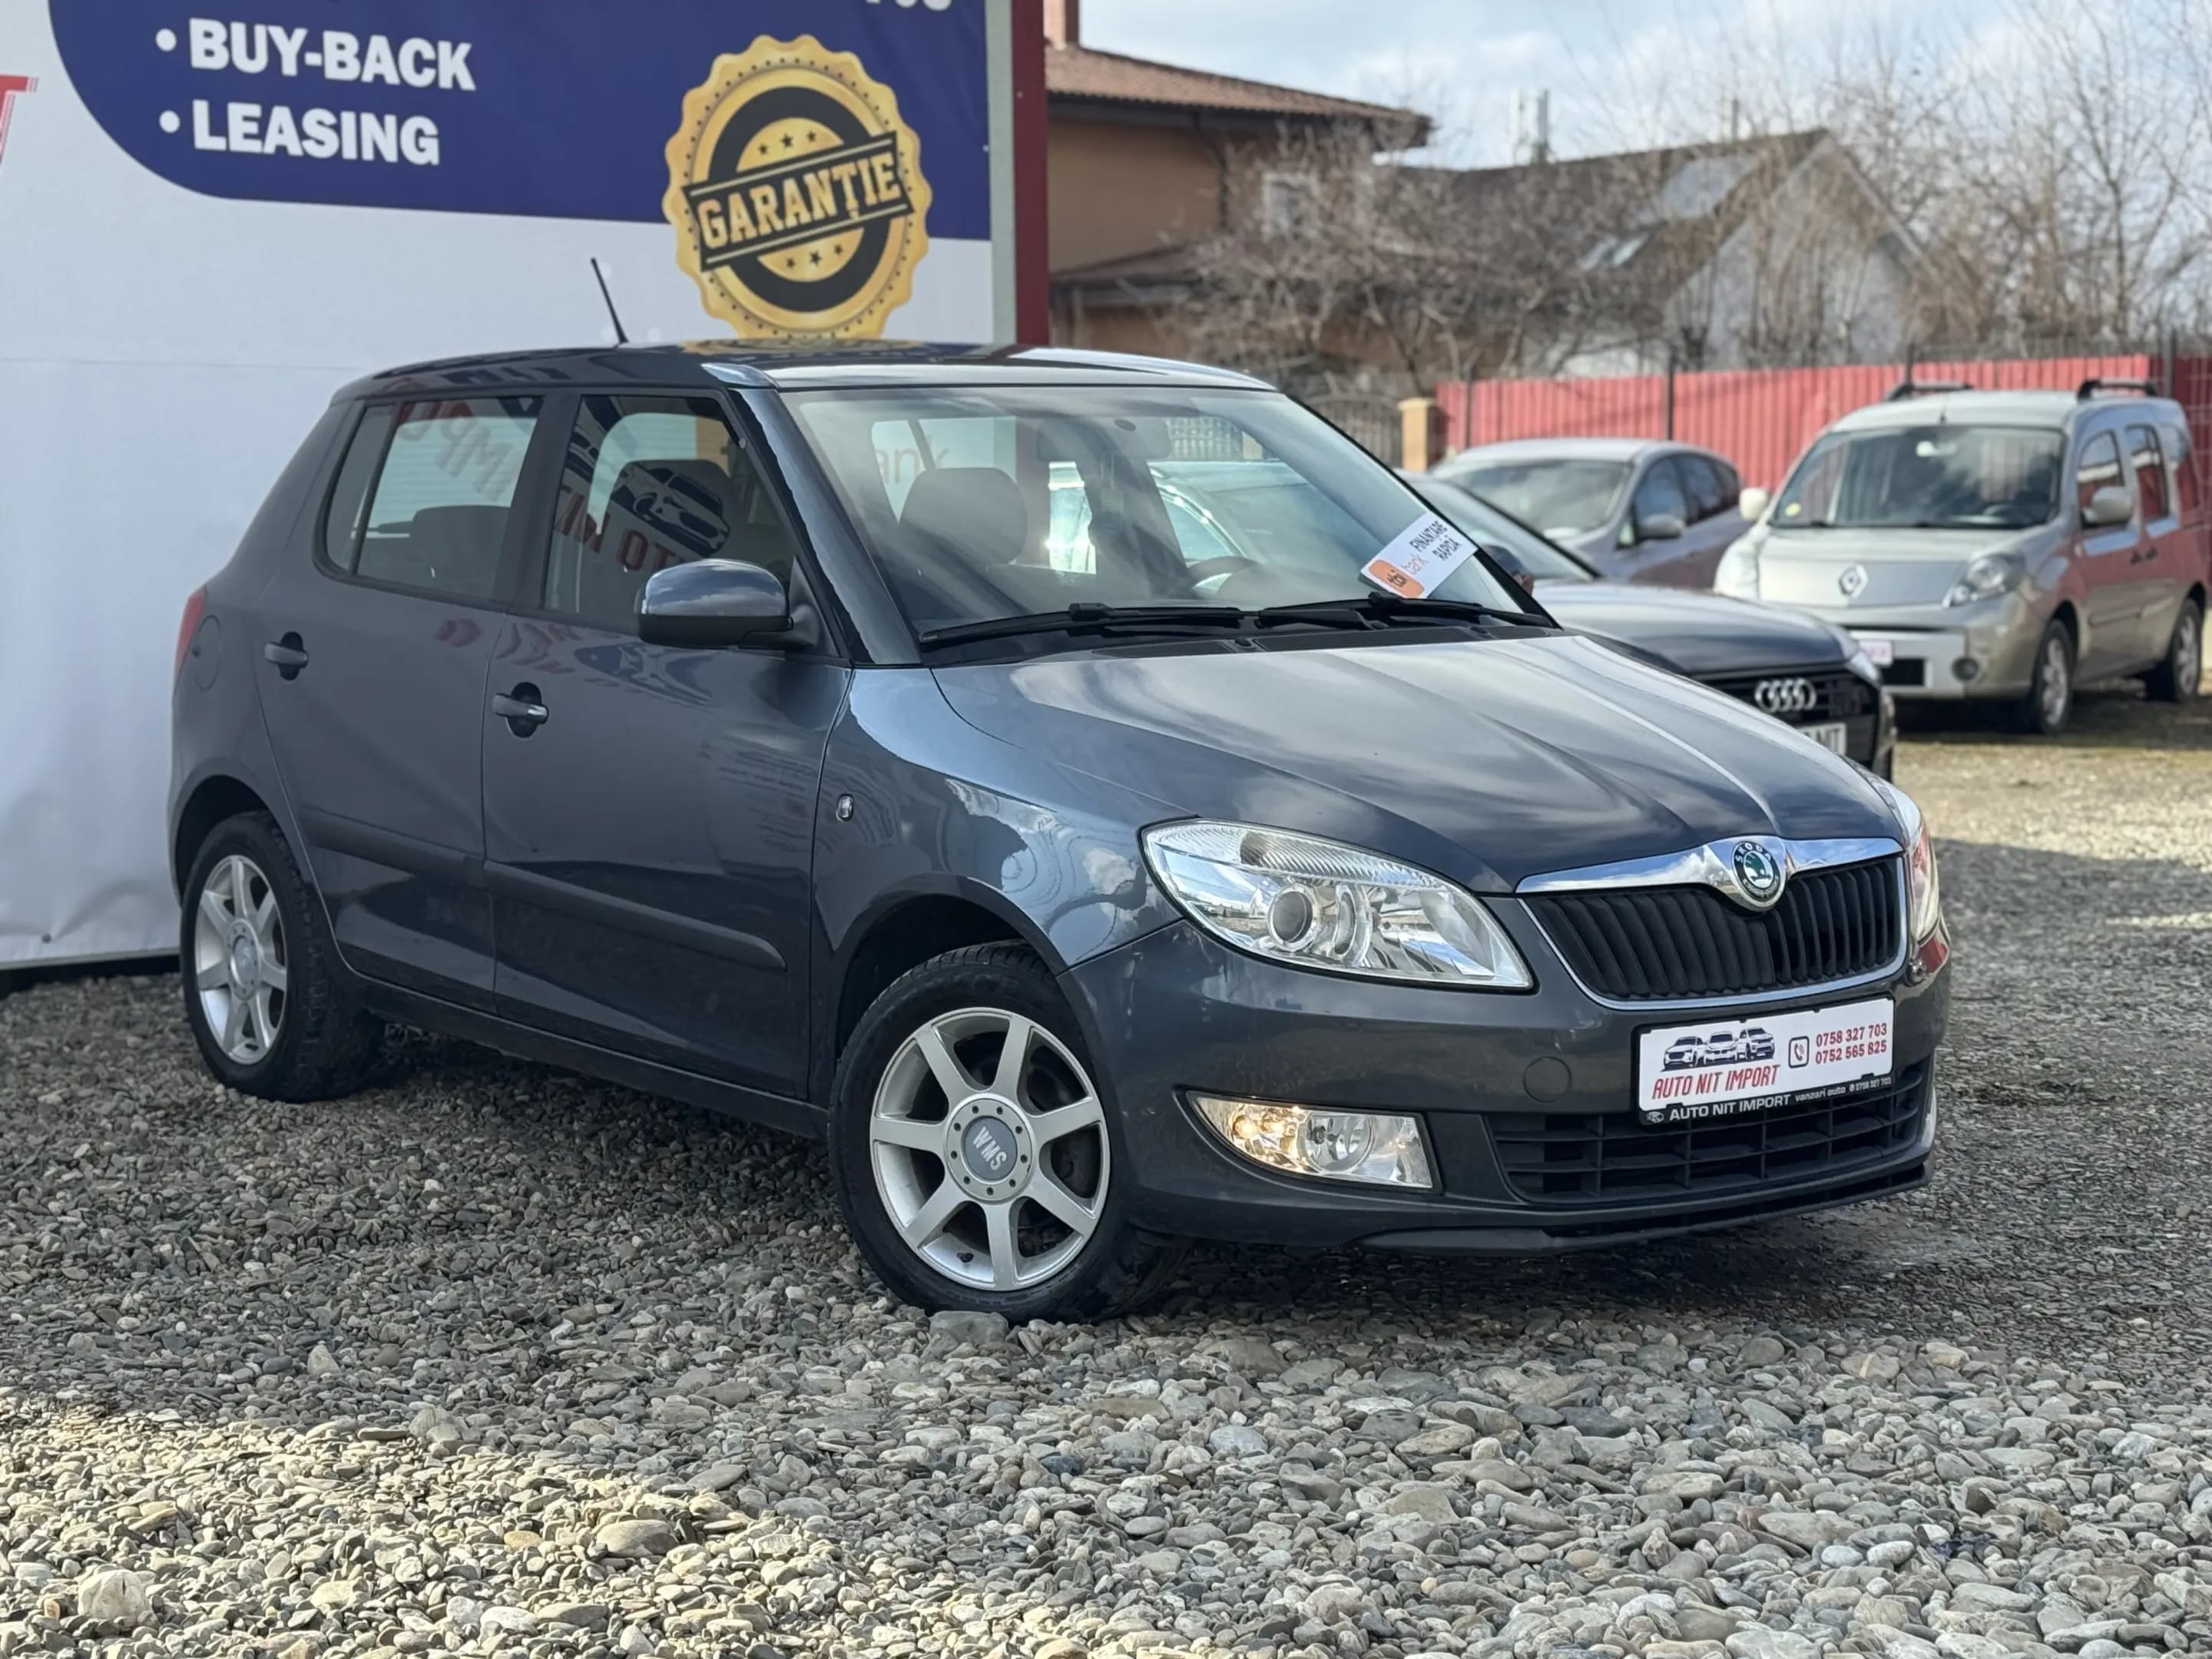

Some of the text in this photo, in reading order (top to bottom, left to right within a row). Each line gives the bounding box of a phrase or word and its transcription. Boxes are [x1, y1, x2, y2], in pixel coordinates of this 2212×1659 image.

[189, 18, 476, 91] BUY-BACK
[193, 99, 440, 166] LEASING
[1400, 553, 1429, 575] bank
[1816, 1022, 1887, 1047] 0758 327 703
[1815, 1039, 1887, 1065] 0752 565 825
[1652, 1065, 1780, 1100] AUTO NIT IMPORT
[1669, 1105, 1709, 1121] AUTO
[1713, 1101, 1737, 1116] NIT
[1739, 1094, 1791, 1112] IMPORT
[972, 1126, 1007, 1171] WMS
